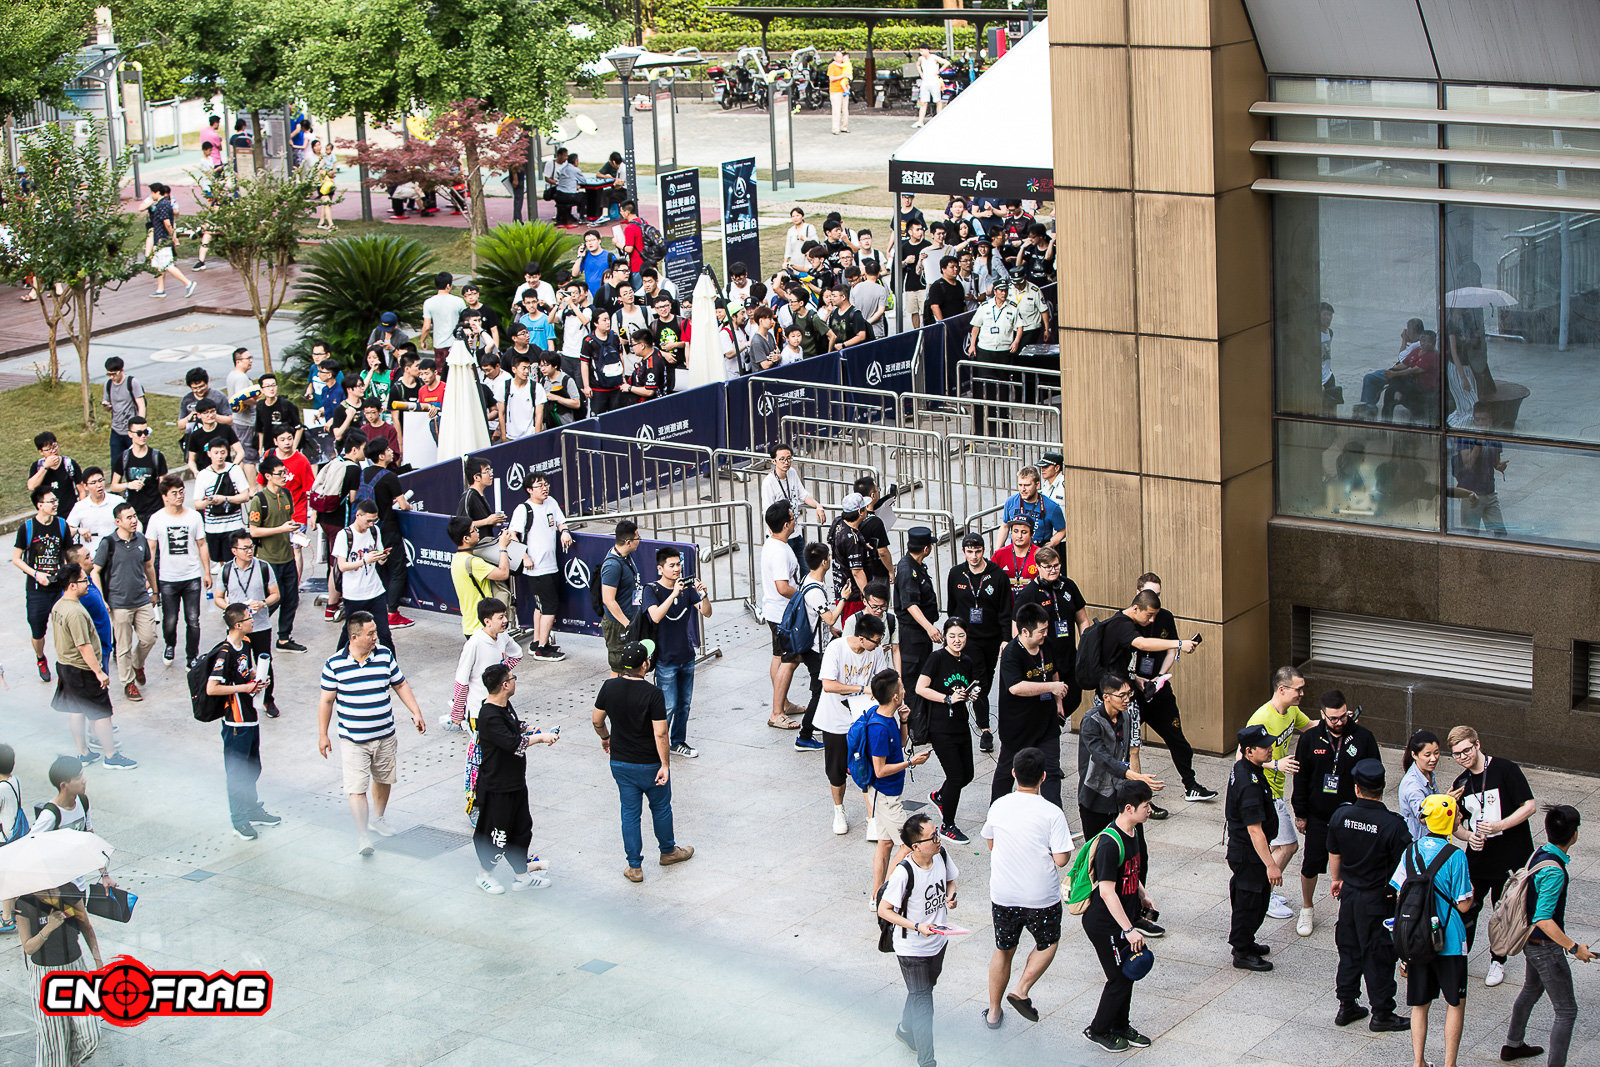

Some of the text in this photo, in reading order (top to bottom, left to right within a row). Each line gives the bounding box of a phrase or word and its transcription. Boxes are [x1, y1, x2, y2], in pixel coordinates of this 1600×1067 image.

[901, 170, 935, 186] 签名区
[680, 205, 696, 213] Session
[726, 231, 758, 244] Signing Session
[657, 419, 690, 436] 亚洲邀请赛
[420, 547, 452, 563] 亚洲邀请
[924, 879, 946, 901] CN
